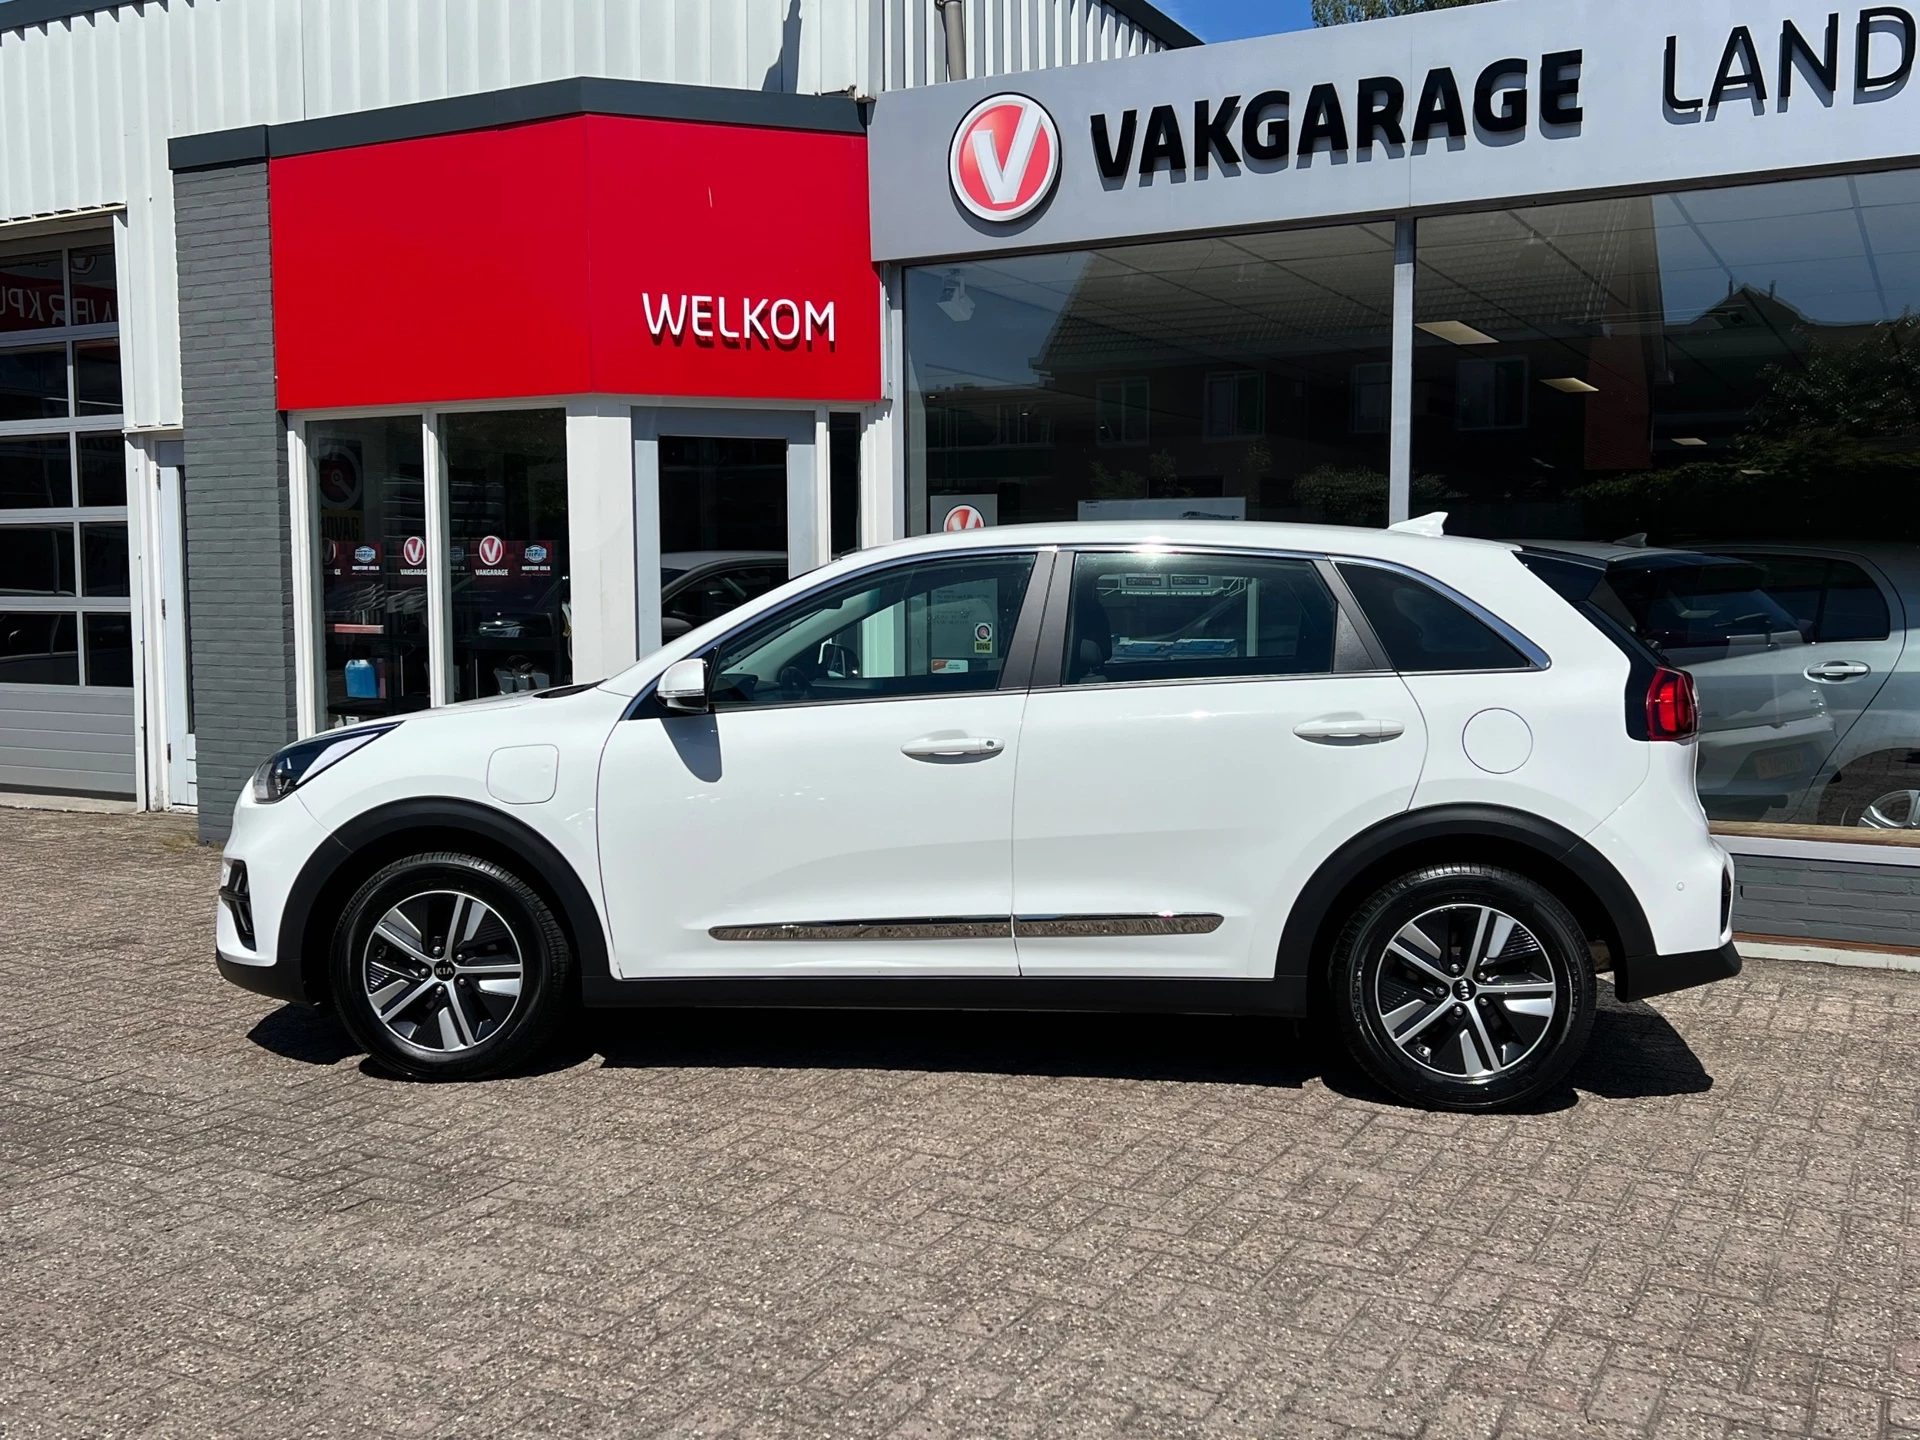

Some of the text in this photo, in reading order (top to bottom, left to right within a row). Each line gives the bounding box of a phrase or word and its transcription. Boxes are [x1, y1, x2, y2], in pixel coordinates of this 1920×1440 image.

[1090, 6, 1917, 178] VAKGARAGE LAND
[642, 292, 835, 342] WELKOM
[475, 568, 509, 576] VAKGARAGE
[435, 967, 454, 975] KIA
[1458, 980, 1470, 1000] KIA
